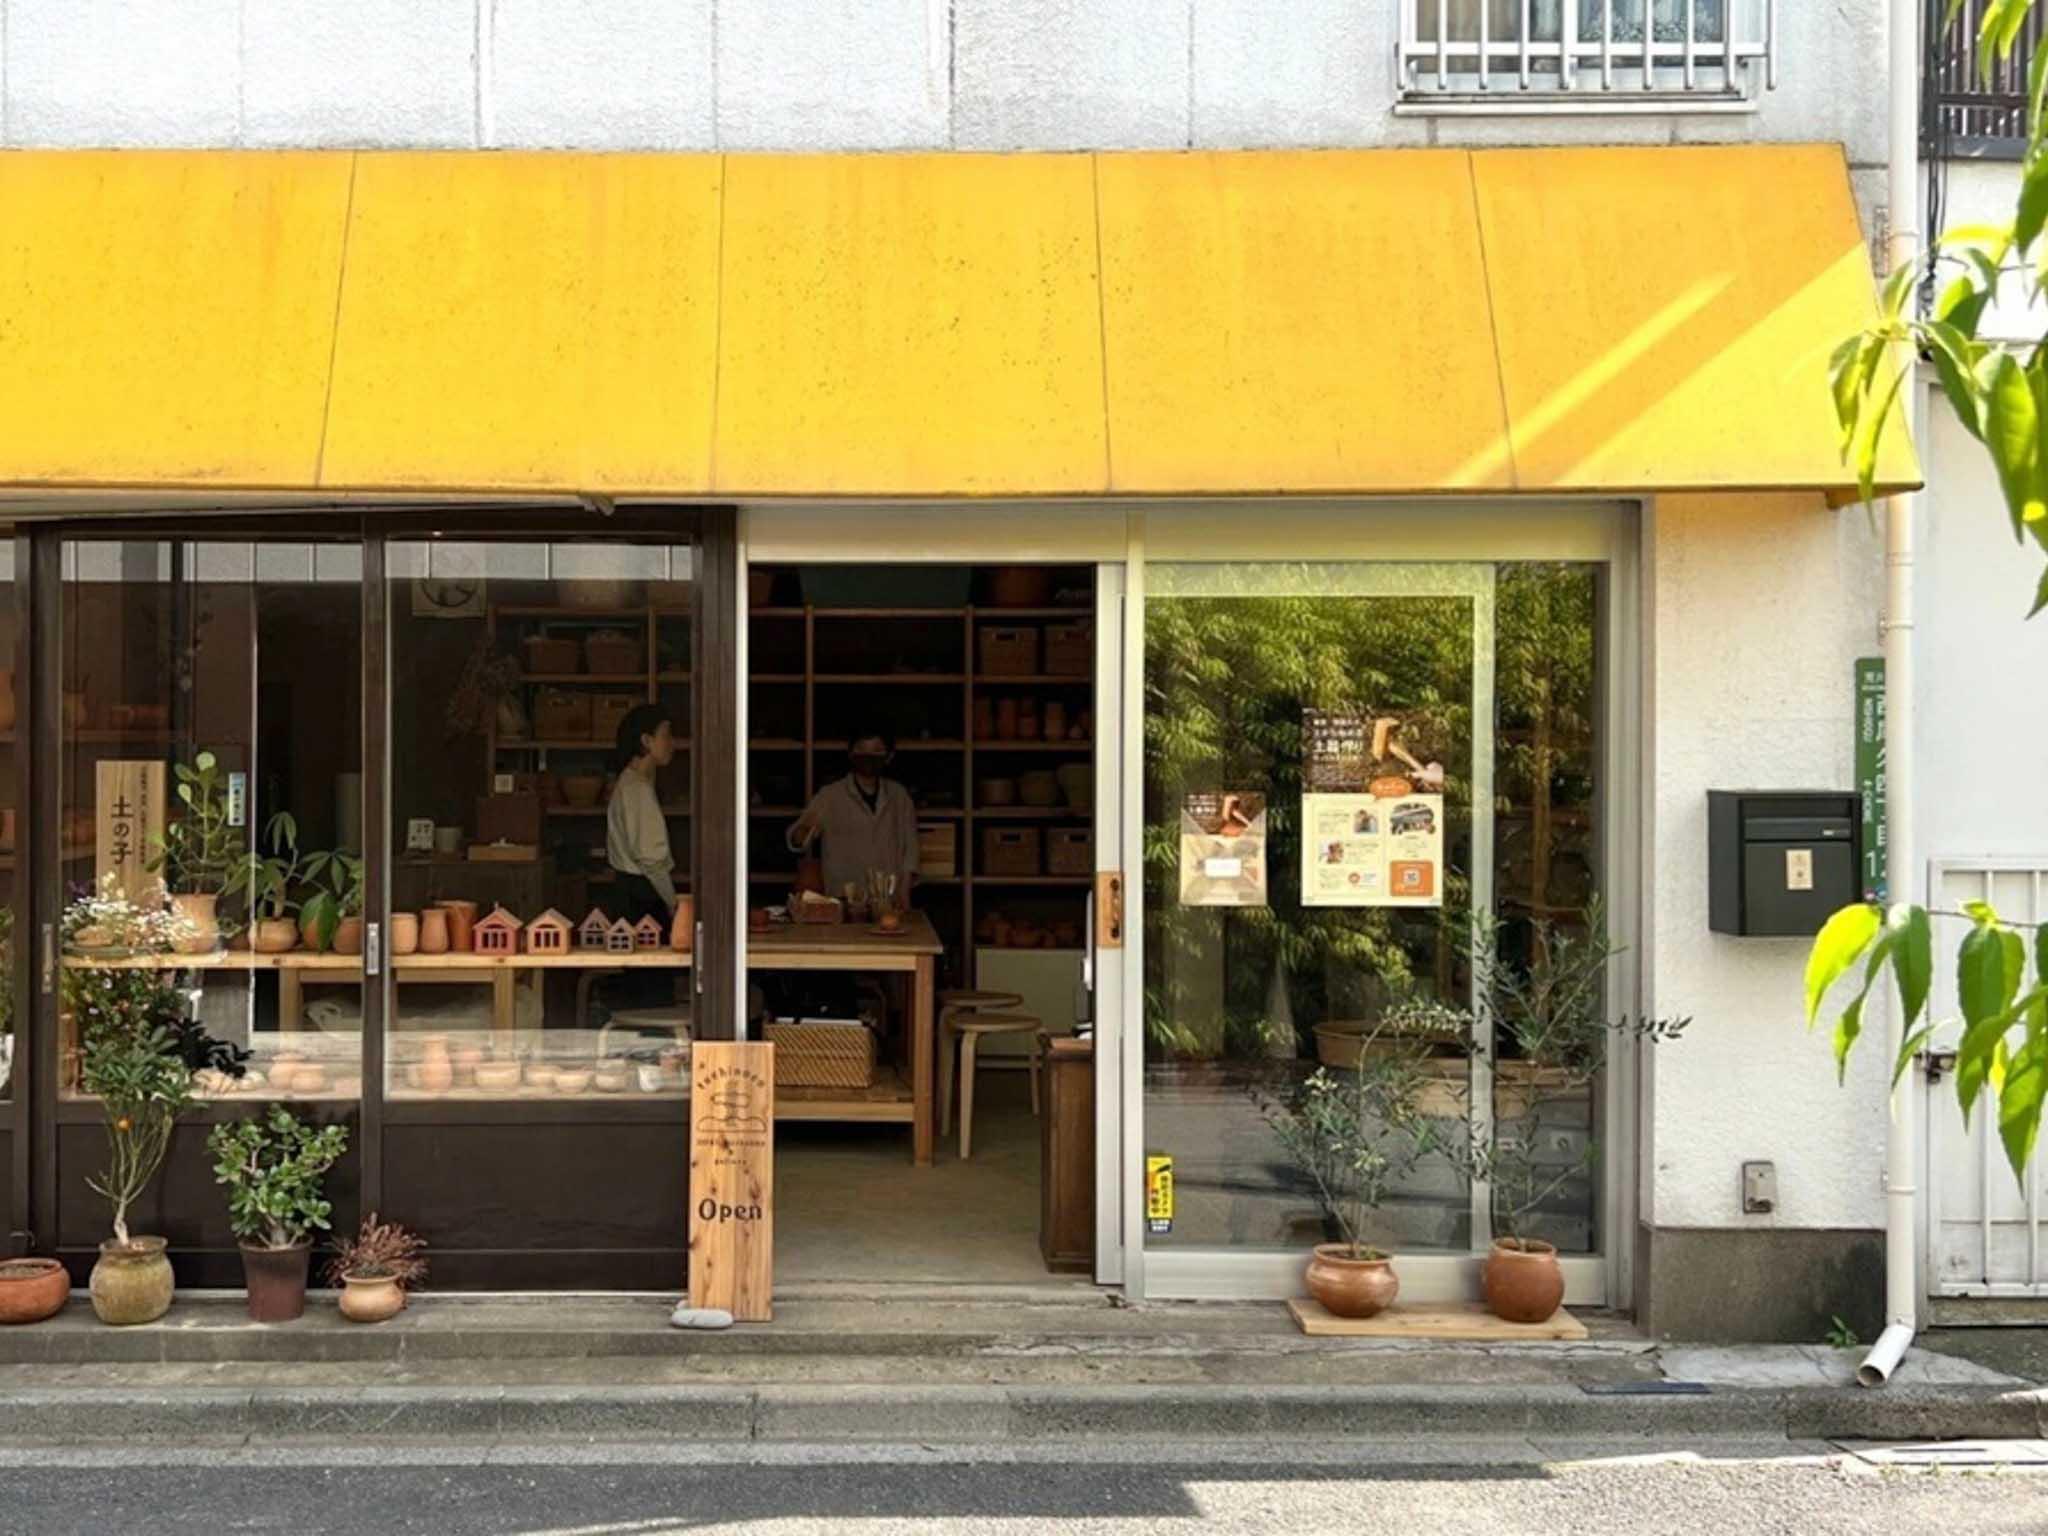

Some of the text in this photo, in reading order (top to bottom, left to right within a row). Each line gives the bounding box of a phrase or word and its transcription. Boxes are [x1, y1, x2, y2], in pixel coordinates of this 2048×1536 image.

[110, 795, 134, 865] 土の子
[699, 1198, 762, 1224] Open
